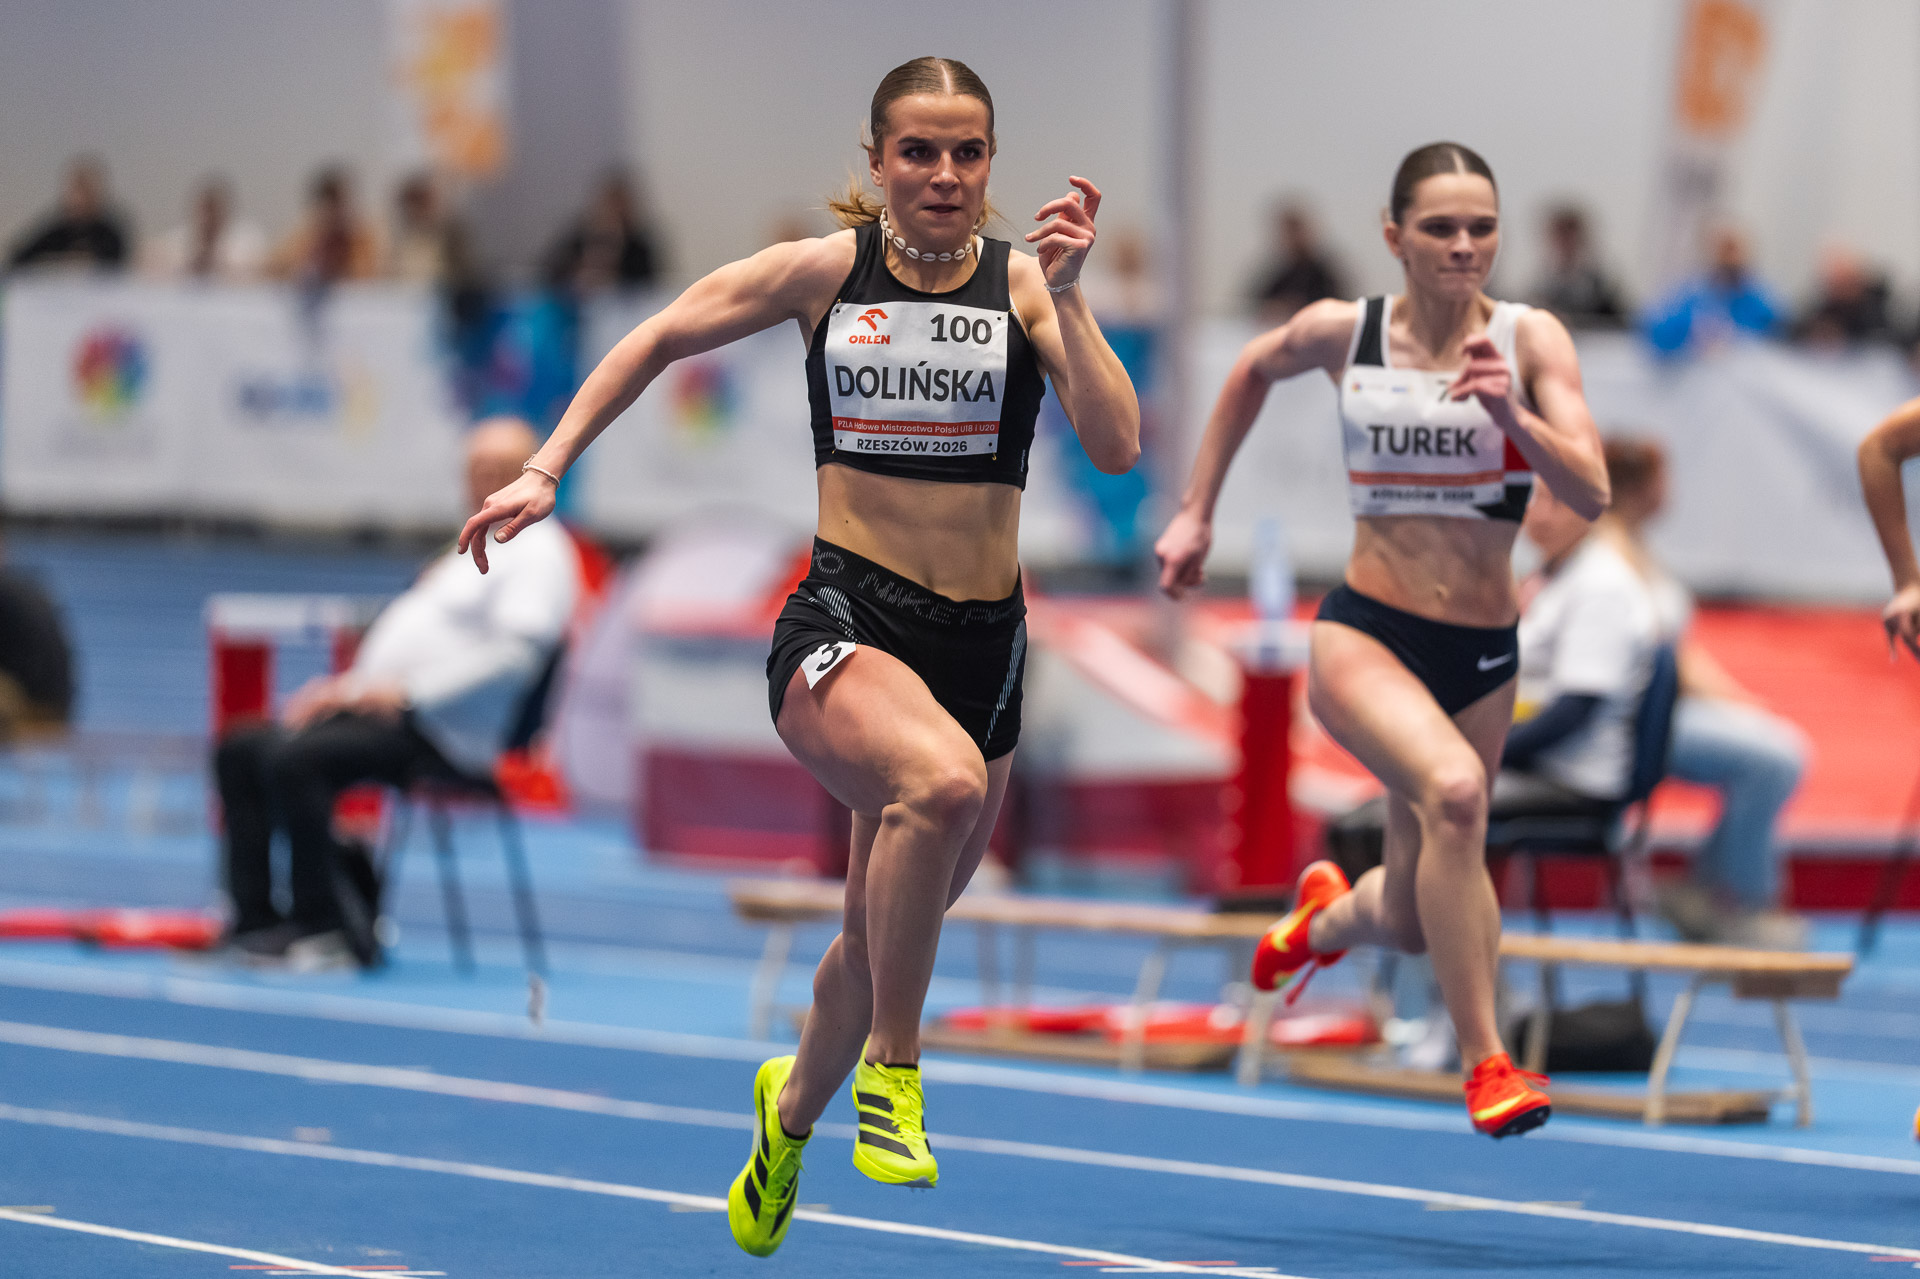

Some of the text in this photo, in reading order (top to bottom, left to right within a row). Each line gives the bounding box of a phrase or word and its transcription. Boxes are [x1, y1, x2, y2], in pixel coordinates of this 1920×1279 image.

[849, 335, 890, 345] ORLEN
[931, 314, 993, 344] 100
[834, 361, 996, 403] DOLIŃSKA
[838, 420, 853, 430] PZLA
[854, 422, 880, 432] Halowe
[881, 424, 933, 434] Mistrzostwa
[934, 425, 959, 435] Polski
[960, 424, 973, 433] U18
[980, 423, 995, 432] U20
[1368, 425, 1477, 457] TUREK
[857, 437, 968, 453] RZESZÓW 2026
[816, 642, 843, 671] 3
